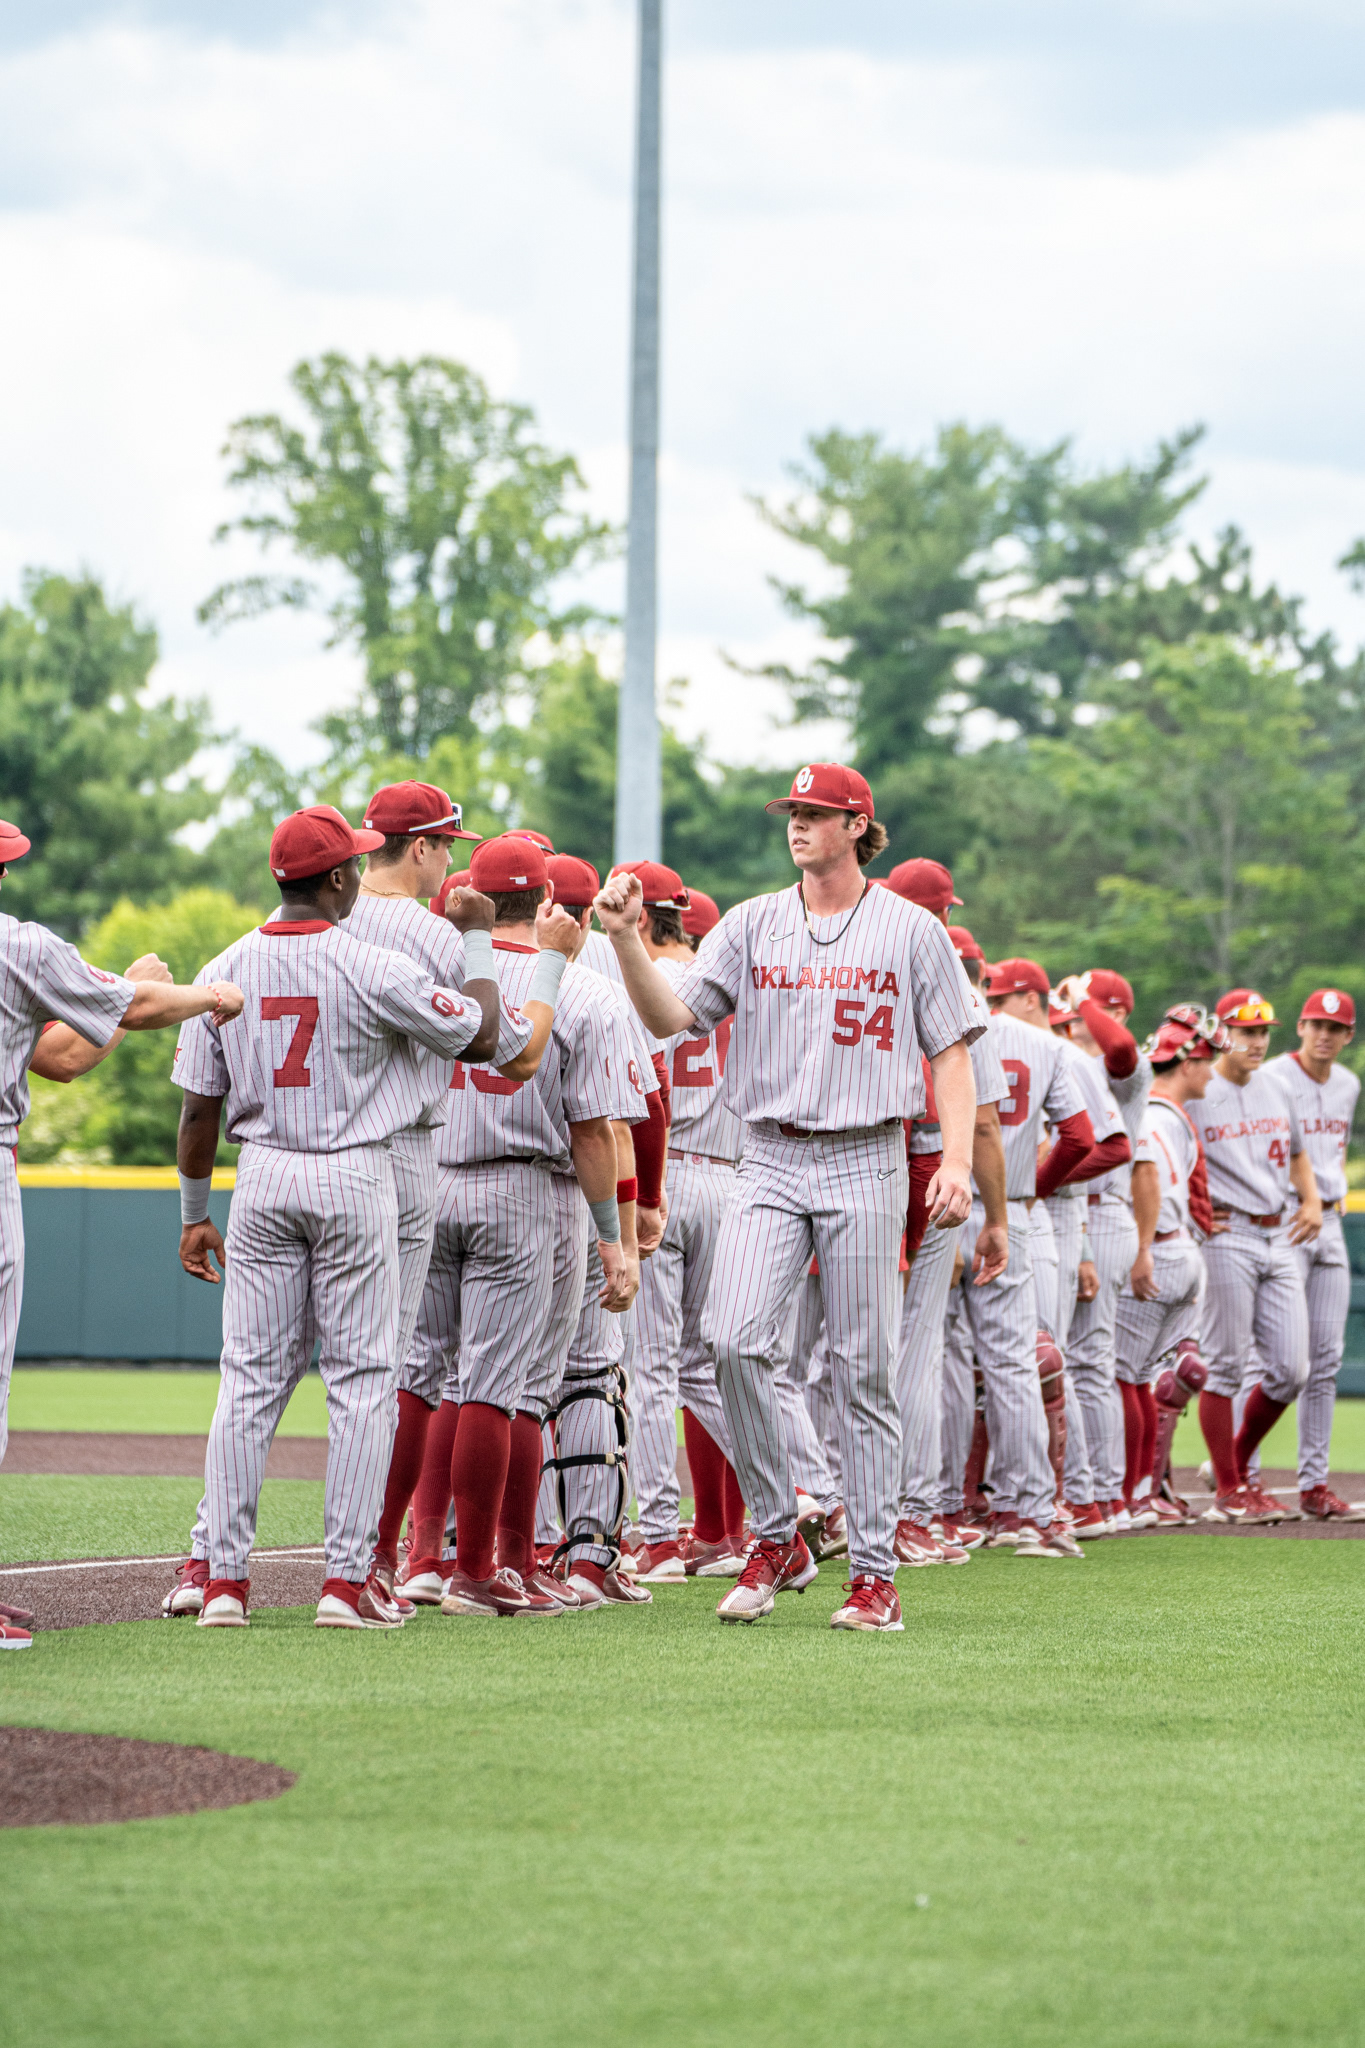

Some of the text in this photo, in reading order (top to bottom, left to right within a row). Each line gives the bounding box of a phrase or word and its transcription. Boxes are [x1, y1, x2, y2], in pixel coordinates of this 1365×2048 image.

[796, 766, 815, 793] OU
[751, 965, 900, 998] OKLAHOMA
[261, 996, 320, 1088] 7
[832, 998, 894, 1052] 54
